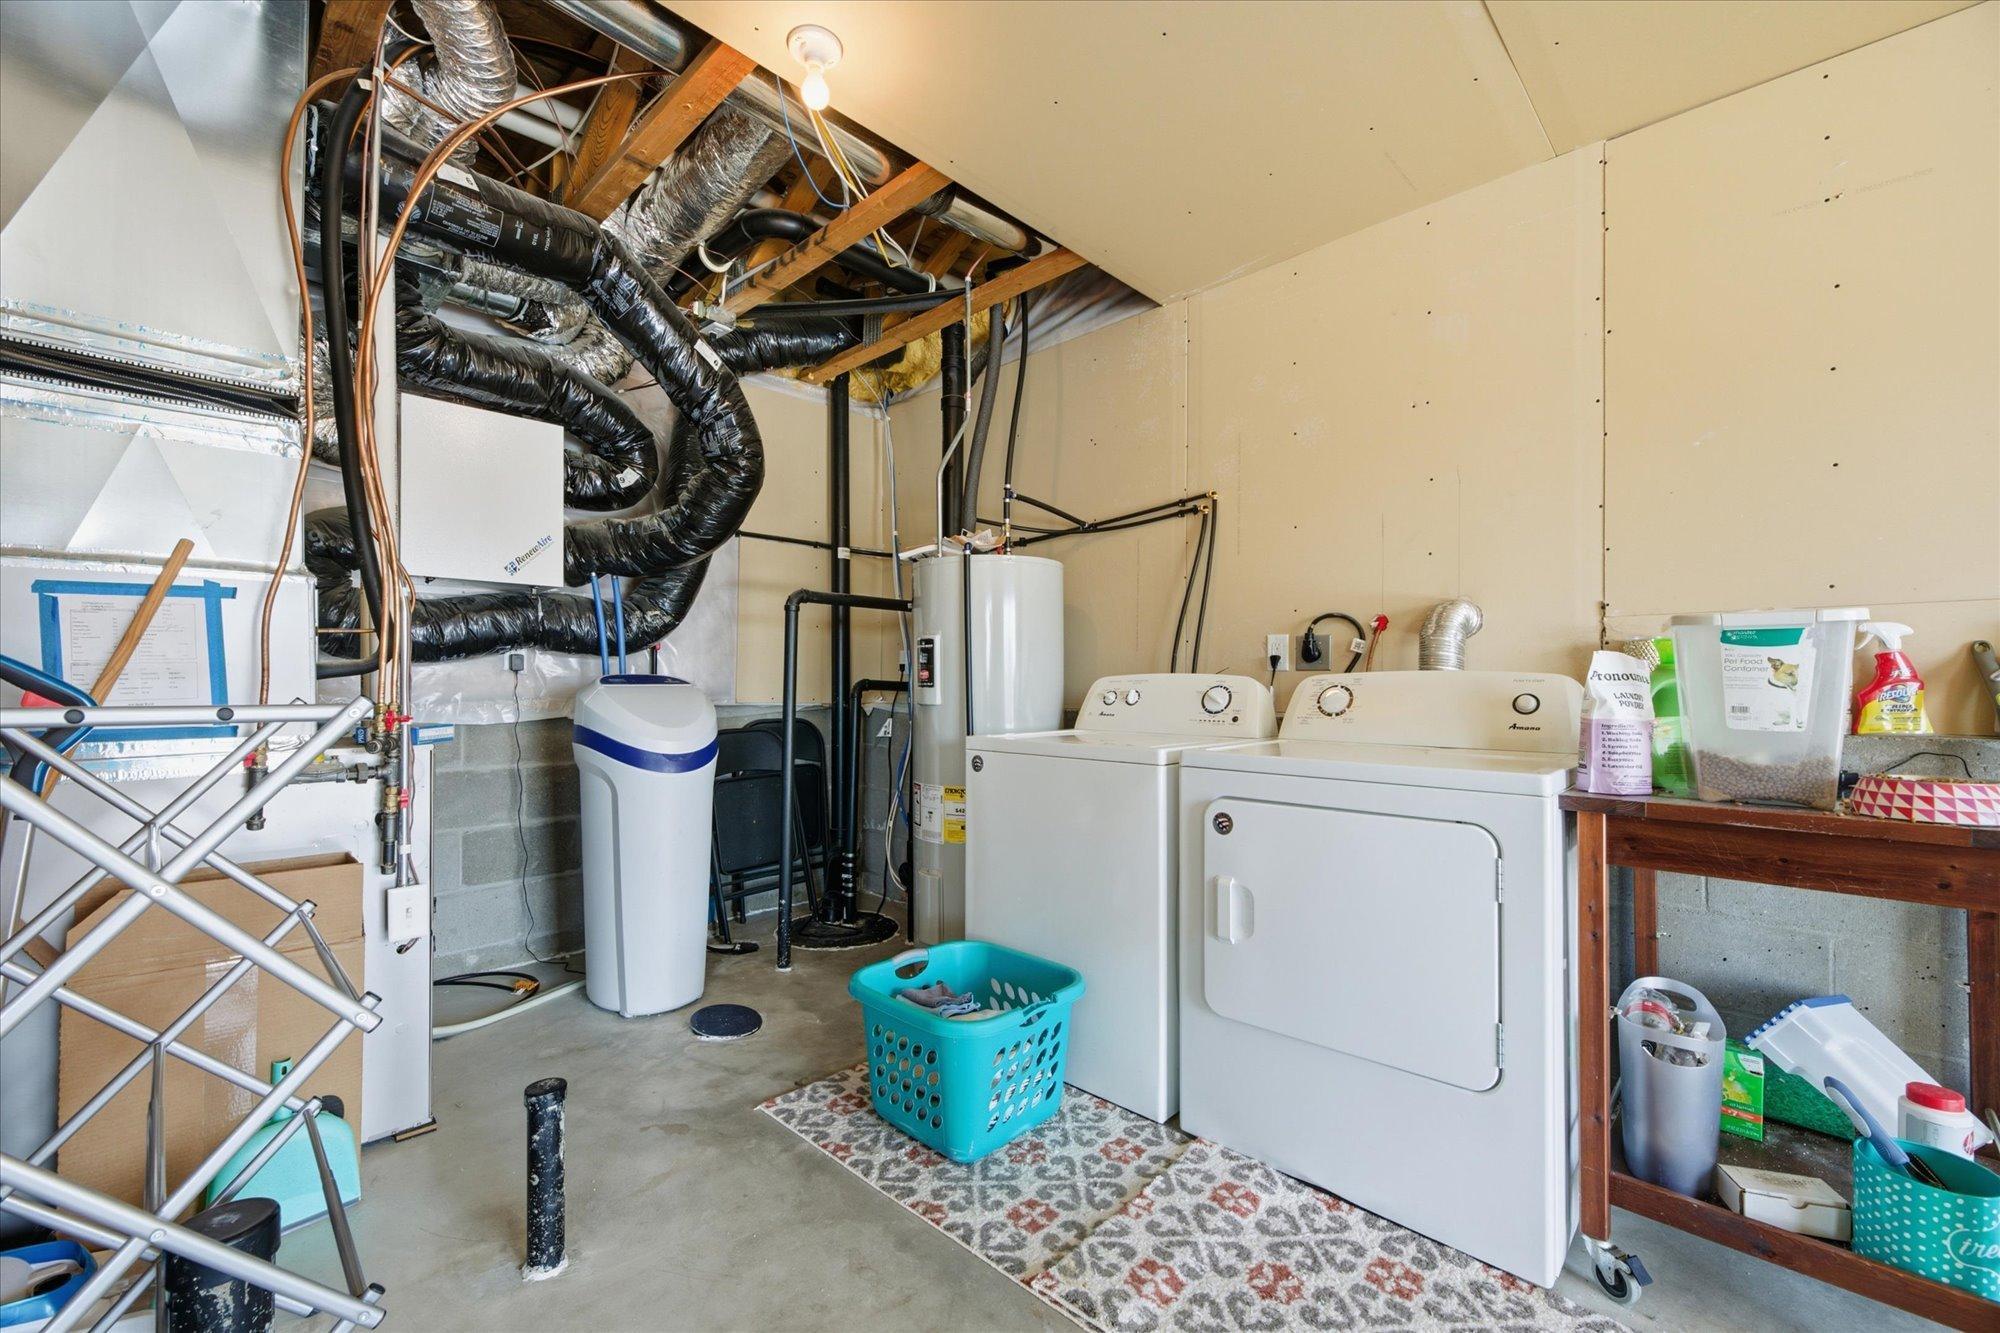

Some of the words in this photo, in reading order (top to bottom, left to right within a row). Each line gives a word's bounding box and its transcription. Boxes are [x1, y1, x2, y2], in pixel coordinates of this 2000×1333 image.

[515, 535, 553, 566] RenewAire
[1724, 657, 1738, 665] Pet
[1740, 657, 1763, 665] Food
[1723, 665, 1769, 673] Container
[1508, 723, 1541, 731] Amana
